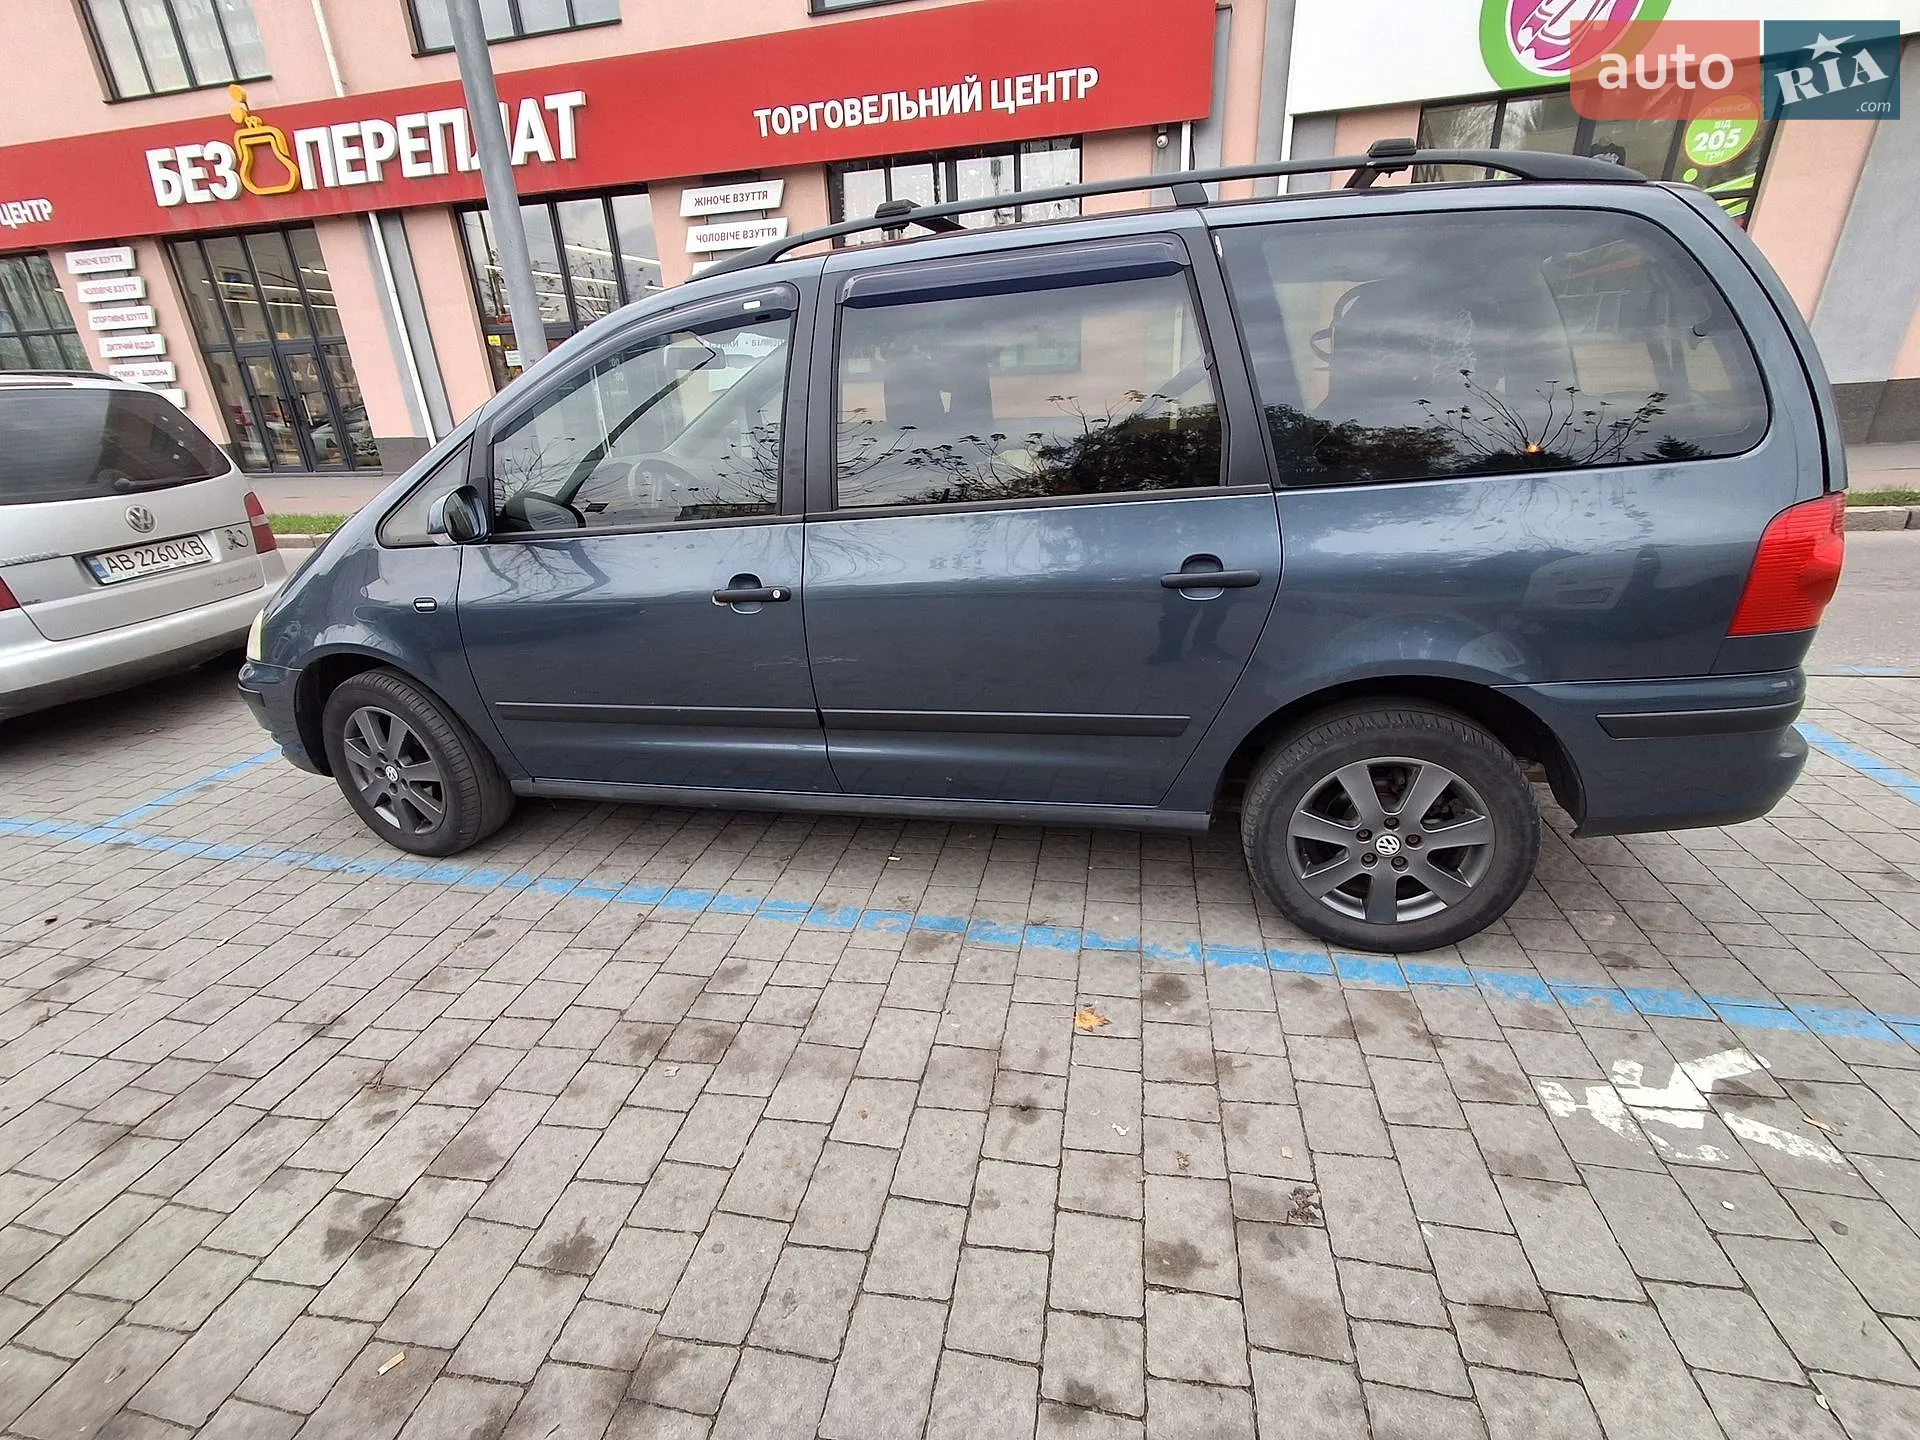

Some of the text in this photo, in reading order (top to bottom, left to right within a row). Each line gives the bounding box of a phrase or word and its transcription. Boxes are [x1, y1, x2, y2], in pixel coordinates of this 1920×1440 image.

[753, 66, 1099, 137] ТОРГОВЕЛЬНИЙ ЦЕНТР
[1692, 127, 1742, 152] 205
[145, 140, 242, 207] БЕЗ
[694, 190, 768, 207] ЖІНОЧЕ ВЗУТТЯ
[0, 198, 53, 230] ЦЕНТР
[696, 227, 777, 243] ЧОЛОВІЧЕ ВЗУТТЯ
